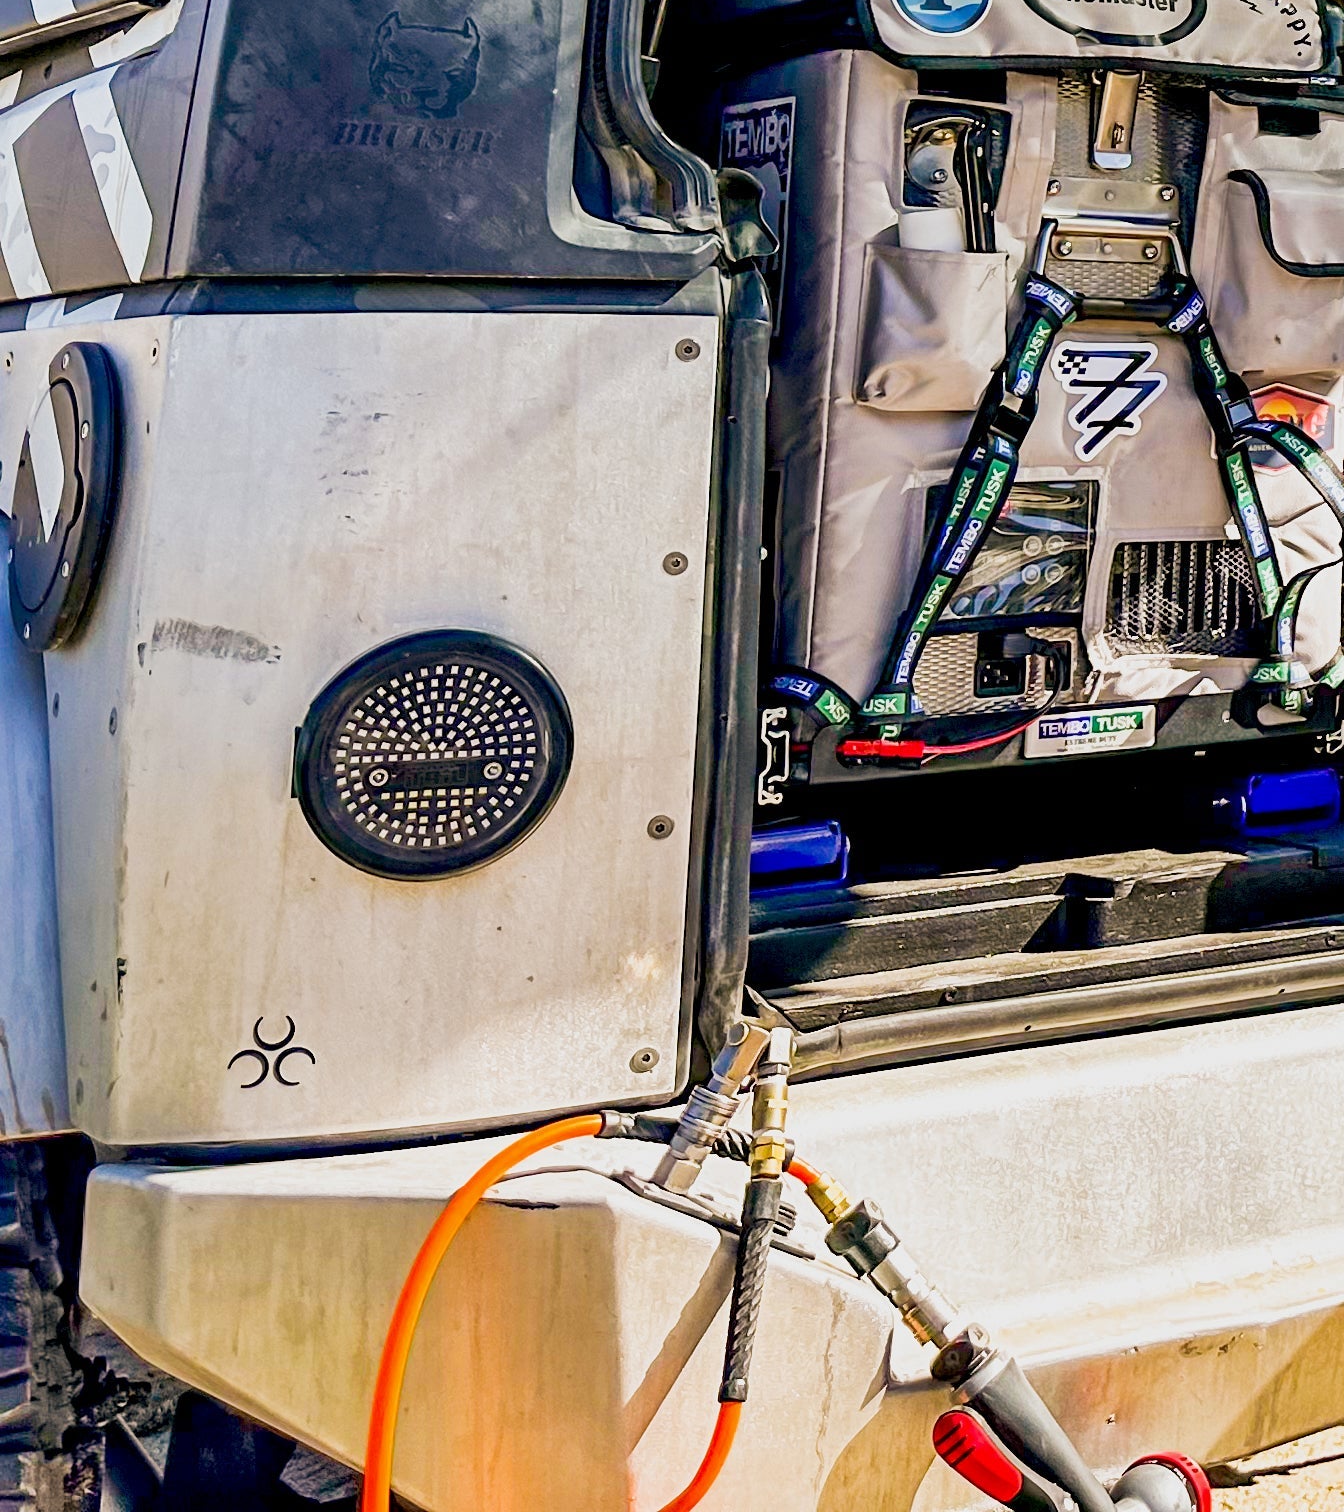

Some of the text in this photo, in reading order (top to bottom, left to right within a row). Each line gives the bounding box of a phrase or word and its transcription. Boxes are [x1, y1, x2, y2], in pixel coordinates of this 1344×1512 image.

[1200, 338, 1228, 385] TUSK
[949, 475, 977, 518] TUSK
[975, 467, 1006, 512] TUSK
[1230, 461, 1252, 504] TUSK
[945, 518, 983, 573] TEMBO
[915, 582, 949, 626] TUSK
[862, 695, 899, 714] USK
[1038, 714, 1139, 737] TEMBO TUSK
